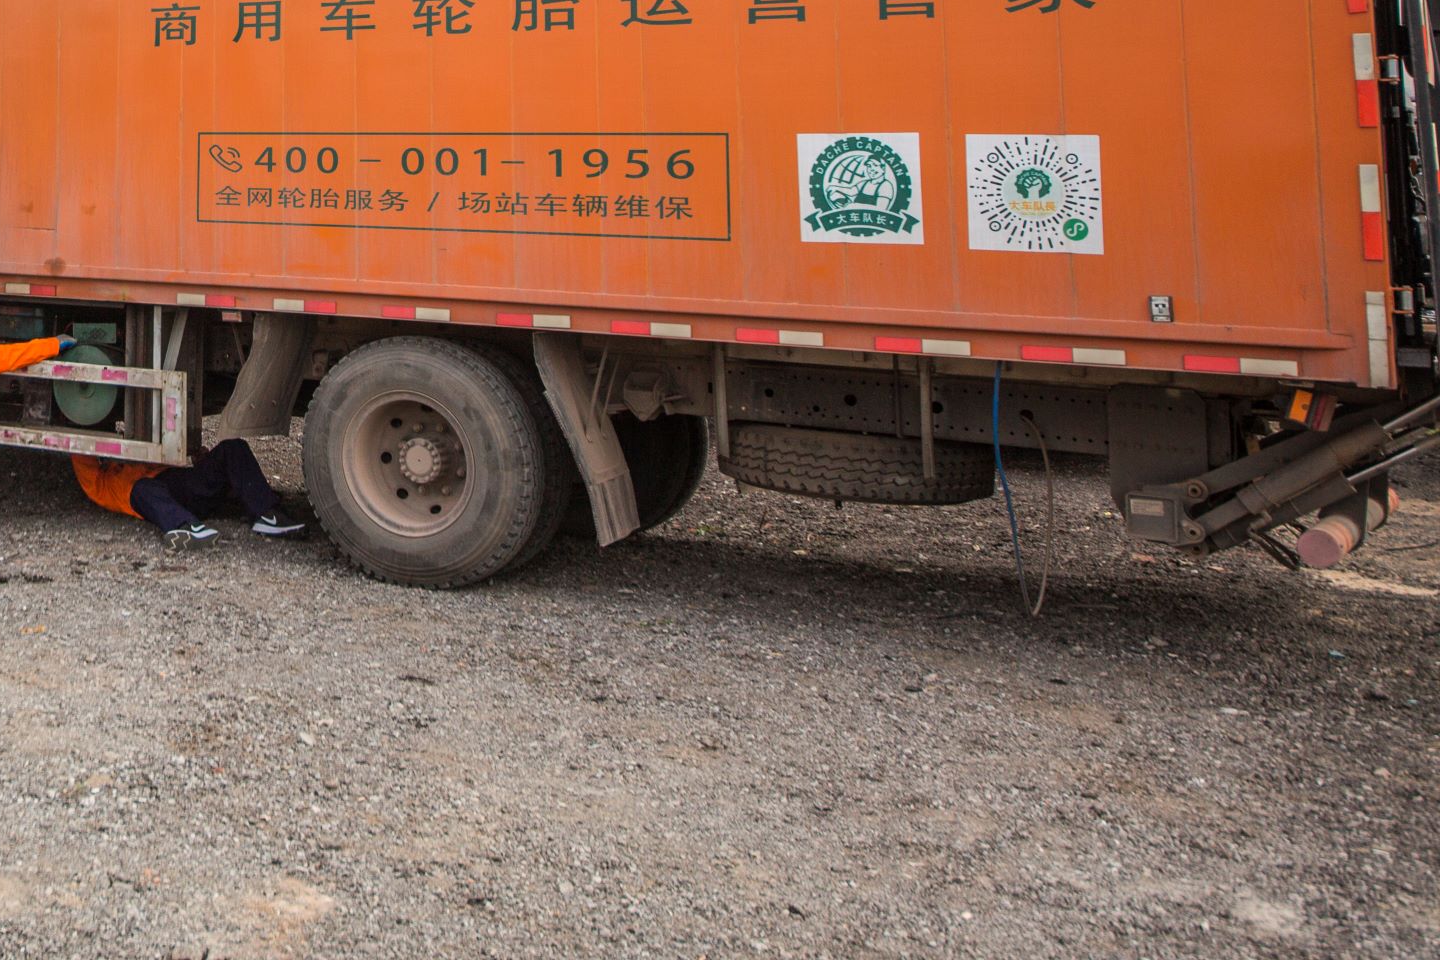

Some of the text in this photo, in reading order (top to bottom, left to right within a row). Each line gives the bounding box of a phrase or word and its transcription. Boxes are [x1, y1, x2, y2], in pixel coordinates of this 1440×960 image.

[816, 141, 905, 177] DACHE CAPTAIN
[215, 185, 410, 213] 全网轮胎服务
[457, 190, 695, 220] 场站车辆维保
[835, 212, 888, 225] 大车队长
